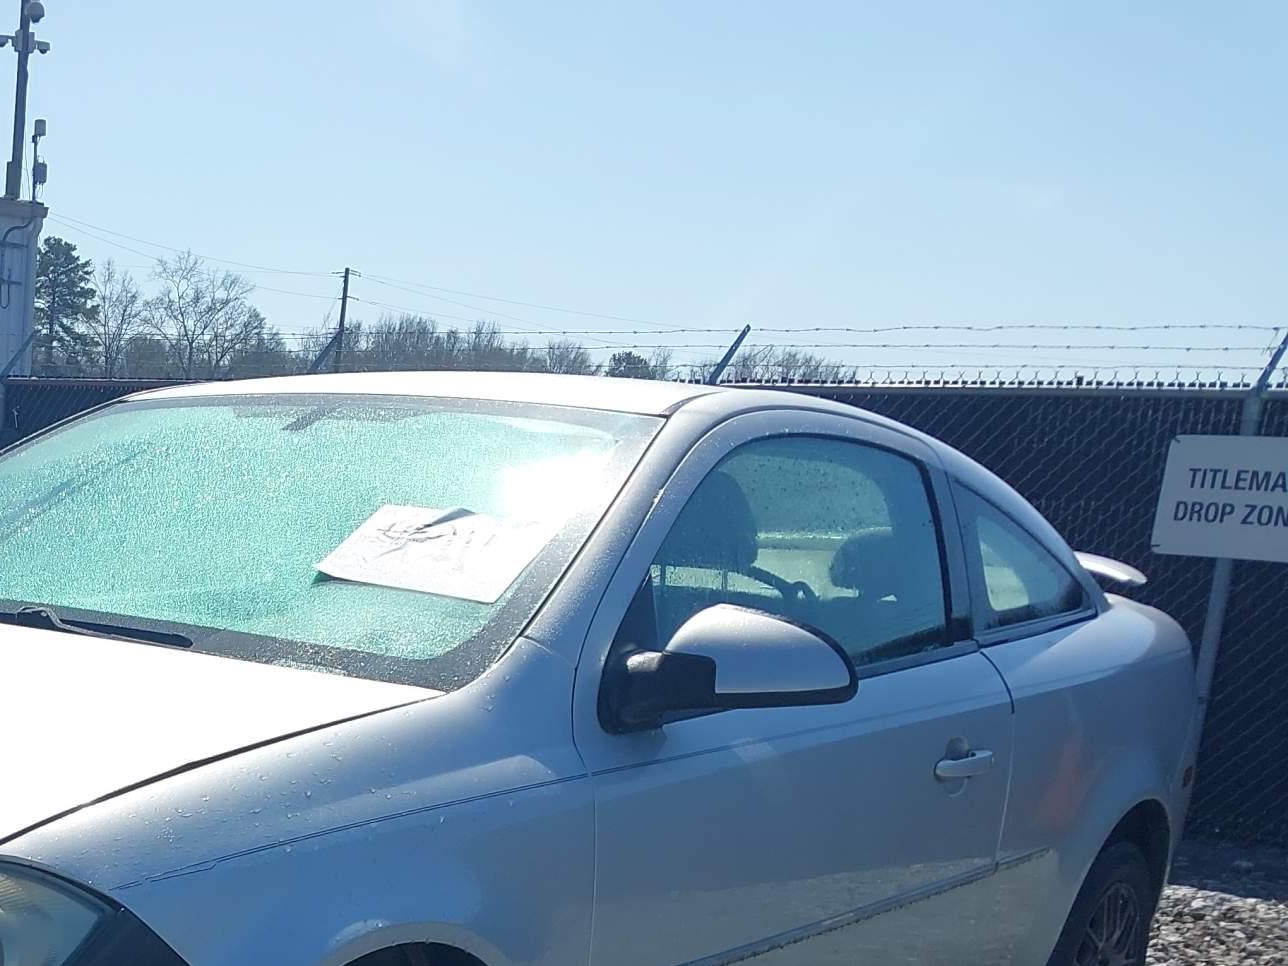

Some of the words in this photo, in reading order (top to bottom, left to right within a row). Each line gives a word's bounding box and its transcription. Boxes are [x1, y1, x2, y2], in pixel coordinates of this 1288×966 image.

[1188, 468, 1288, 492] TITLEMA
[1173, 501, 1235, 523] DROP
[1240, 504, 1288, 527] ZON
